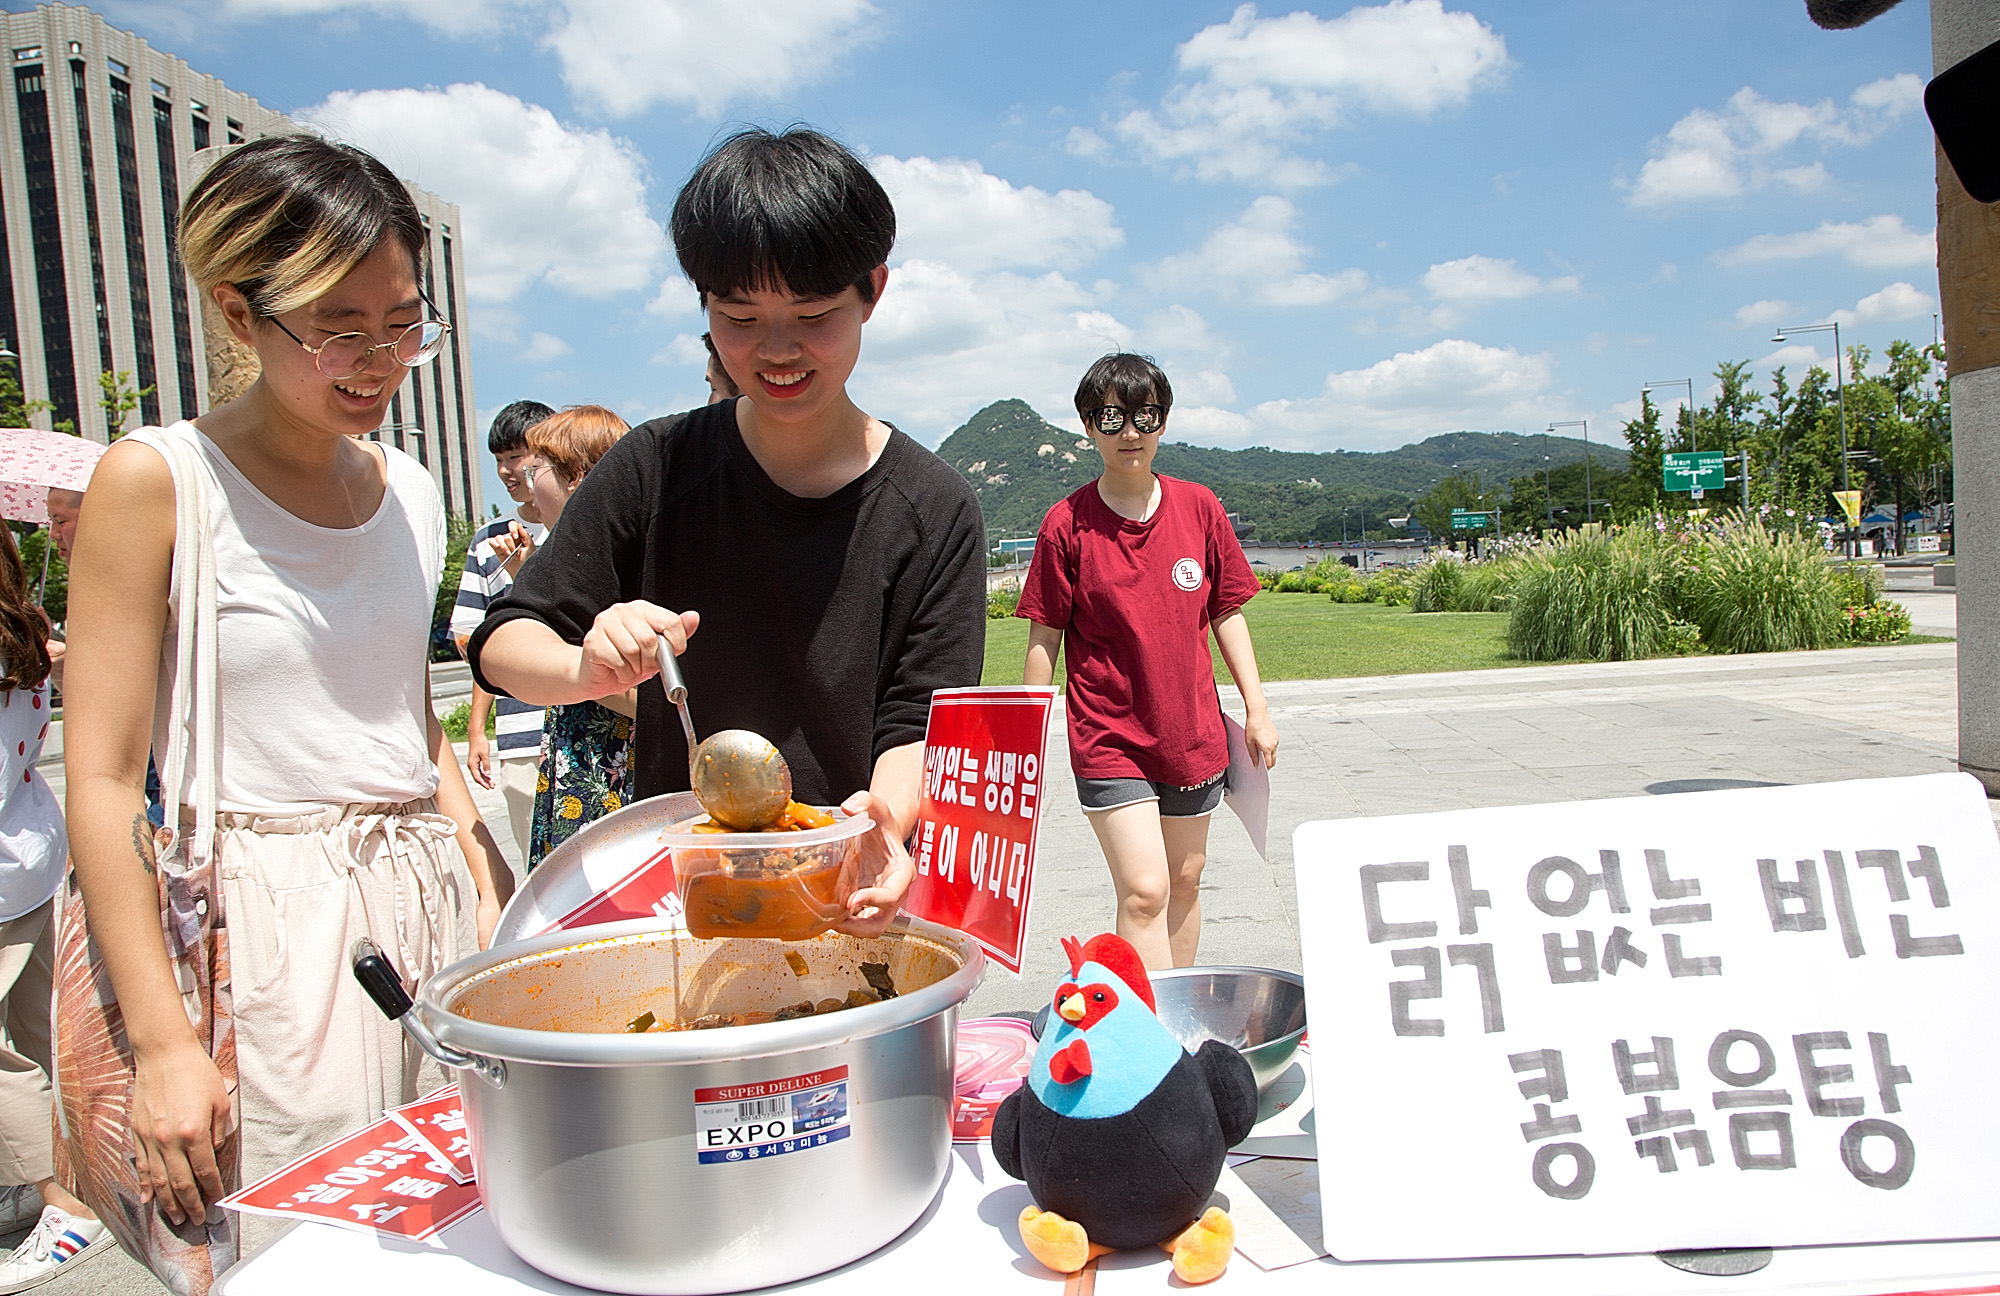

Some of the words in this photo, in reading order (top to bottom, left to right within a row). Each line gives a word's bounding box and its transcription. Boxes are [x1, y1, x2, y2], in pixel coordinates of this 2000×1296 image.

[984, 750, 1038, 819] 생명'은
[970, 829, 1027, 908] 아니다
[1359, 844, 1506, 1037] 닭
[1526, 848, 1723, 984] 없는
[1757, 844, 1965, 959] 비건
[718, 1086, 765, 1100] SUPER
[769, 1074, 823, 1093] DELUXE
[707, 1121, 786, 1147] EXPO
